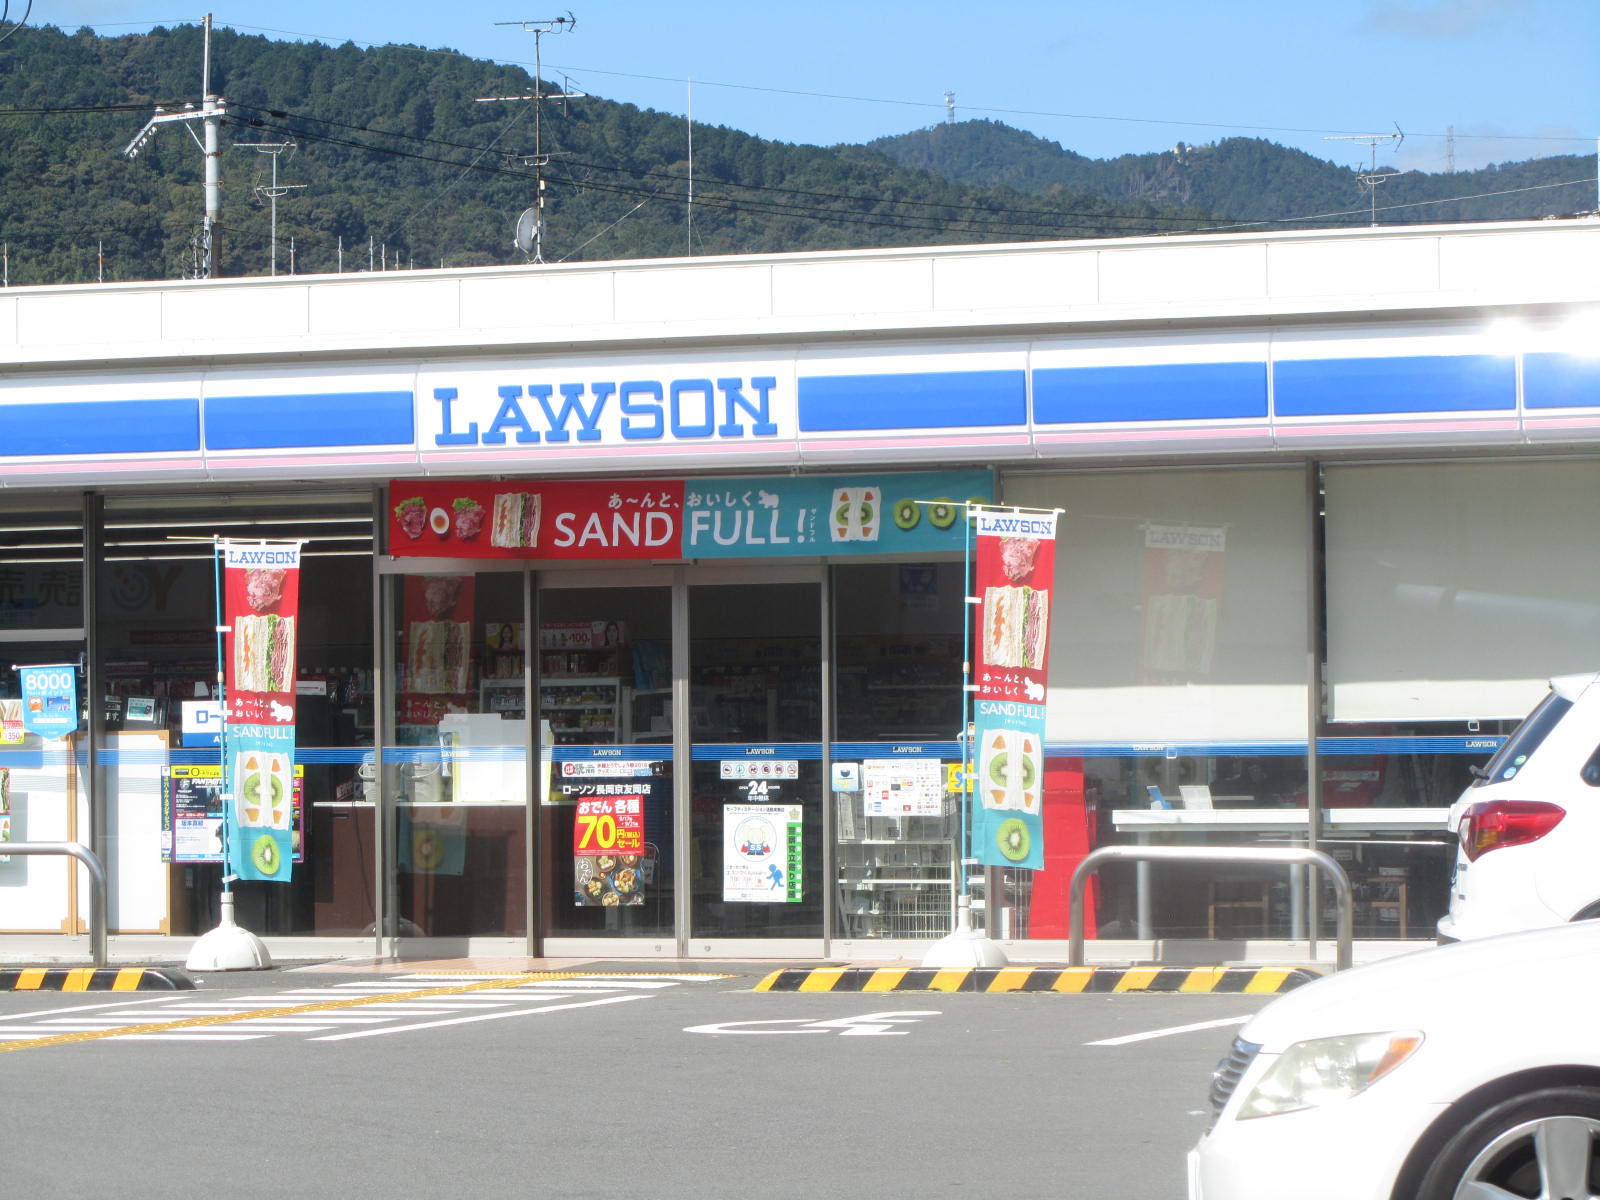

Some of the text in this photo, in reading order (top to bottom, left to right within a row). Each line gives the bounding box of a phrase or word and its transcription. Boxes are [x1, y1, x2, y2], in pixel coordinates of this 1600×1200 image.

[434, 376, 778, 445] LAWSON
[553, 509, 807, 548] SAND FULL!
[981, 518, 1053, 535] LAWSON
[229, 550, 297, 565] LAWSON
[25, 673, 72, 691] 8000
[982, 685, 1019, 695] おいしく
[235, 710, 264, 719] おいしく
[563, 784, 652, 795] ローソン 長岡京友岡店
[748, 780, 768, 795] 24
[578, 799, 640, 814] おでん 各種
[577, 814, 616, 849] 70
[617, 839, 640, 848] セール
